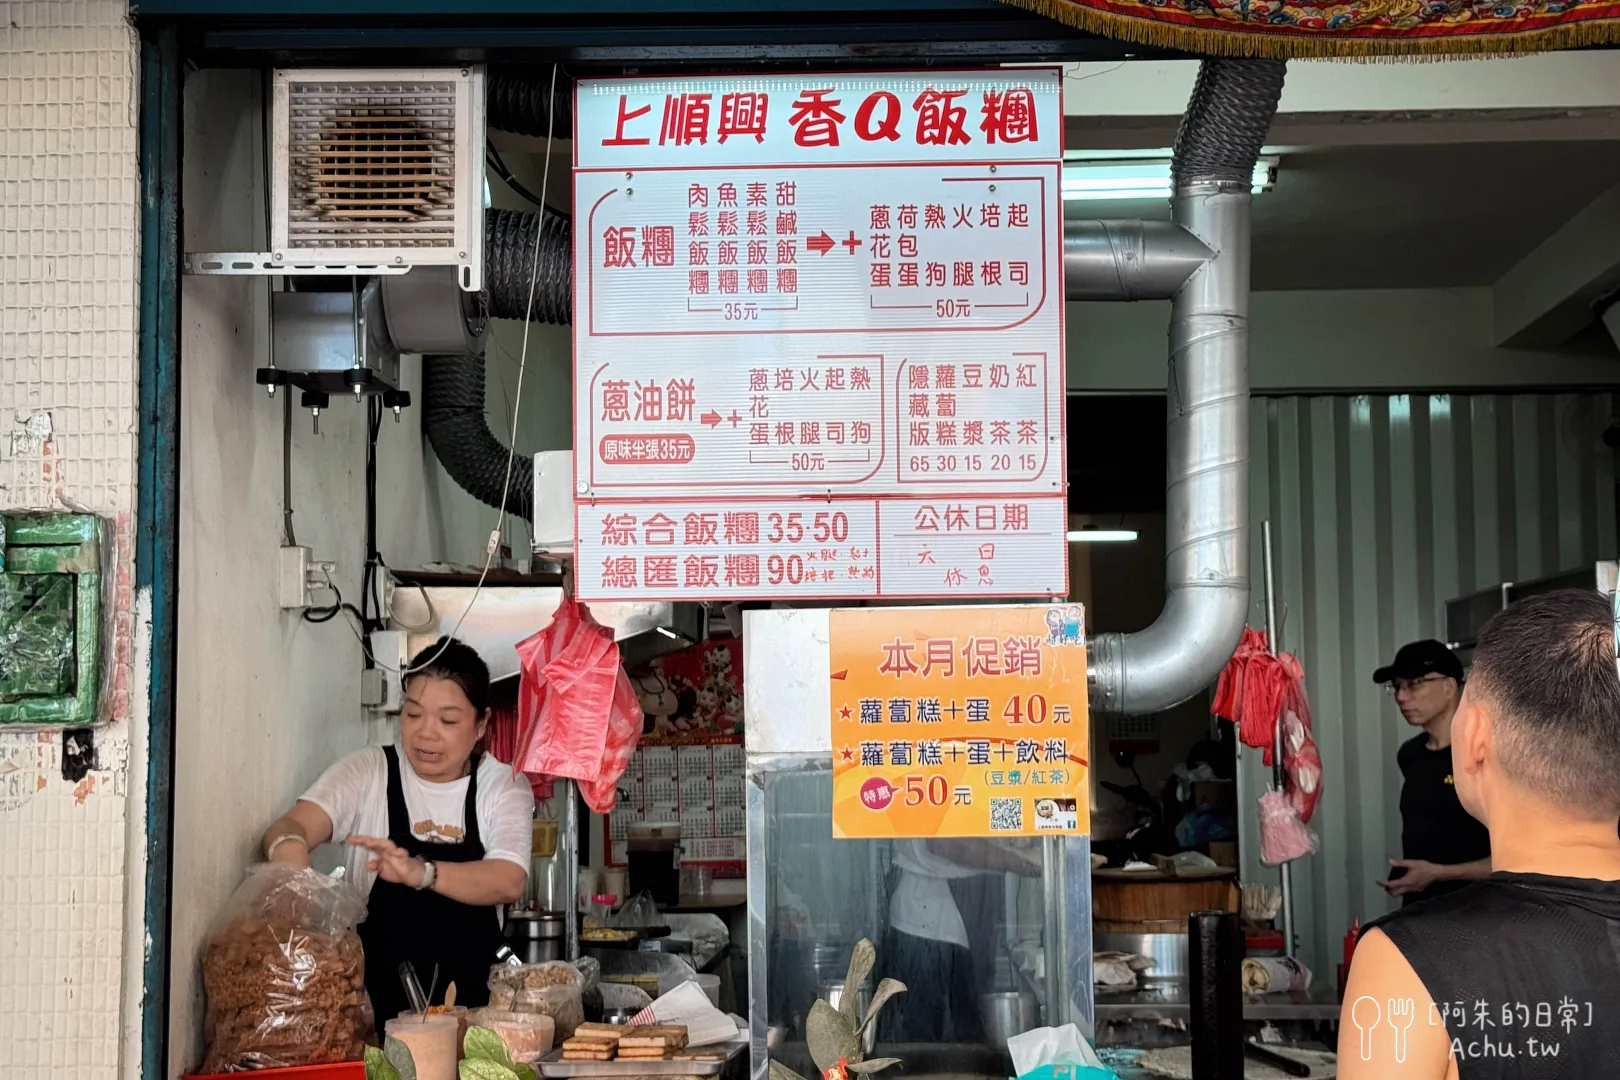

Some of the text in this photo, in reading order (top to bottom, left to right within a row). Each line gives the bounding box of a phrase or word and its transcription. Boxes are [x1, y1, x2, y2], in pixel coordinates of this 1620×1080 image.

[602, 86, 1039, 147] 上順興 香Q飯糰
[603, 226, 674, 268] 飯糰
[688, 183, 709, 294] 肉鬆飯糰
[718, 183, 738, 294] 魚鬆飯糰
[747, 183, 768, 293] 素鬆飯糰
[776, 182, 797, 293] 甜鹹飯糰
[870, 205, 891, 288] 蔥花蛋
[898, 205, 919, 287] 荷包蛋
[925, 204, 946, 287] 熱狗
[952, 203, 975, 287] 火腿
[981, 204, 1001, 286] 培根
[1008, 204, 1029, 286] 起司
[723, 302, 759, 321] 35元
[935, 298, 971, 318] 50元
[602, 378, 696, 421] 蔥油餅
[749, 367, 769, 445] 蔥花蛋
[774, 367, 795, 445] 培根
[800, 367, 820, 445] 火腿
[825, 367, 845, 445] 起司
[850, 366, 871, 444] 熱狗
[909, 365, 929, 446] 隱藏版
[936, 365, 957, 446] 蘿蔔糕
[963, 364, 983, 446] 豆漿
[989, 363, 1011, 445] 奶茶
[1016, 363, 1038, 445] 紅茶
[604, 439, 691, 460] 原味半張35元
[791, 452, 826, 471] 50元
[909, 453, 1038, 472] 65 30 15 20 15
[601, 512, 760, 546] 綜合飯糰
[914, 503, 1029, 532] 公休日期
[601, 554, 803, 589] 總匯飯糰 90
[879, 636, 1043, 678] 本月促銷
[860, 698, 990, 724] 蘿蔔糕+蛋
[863, 784, 892, 803] 特惠
